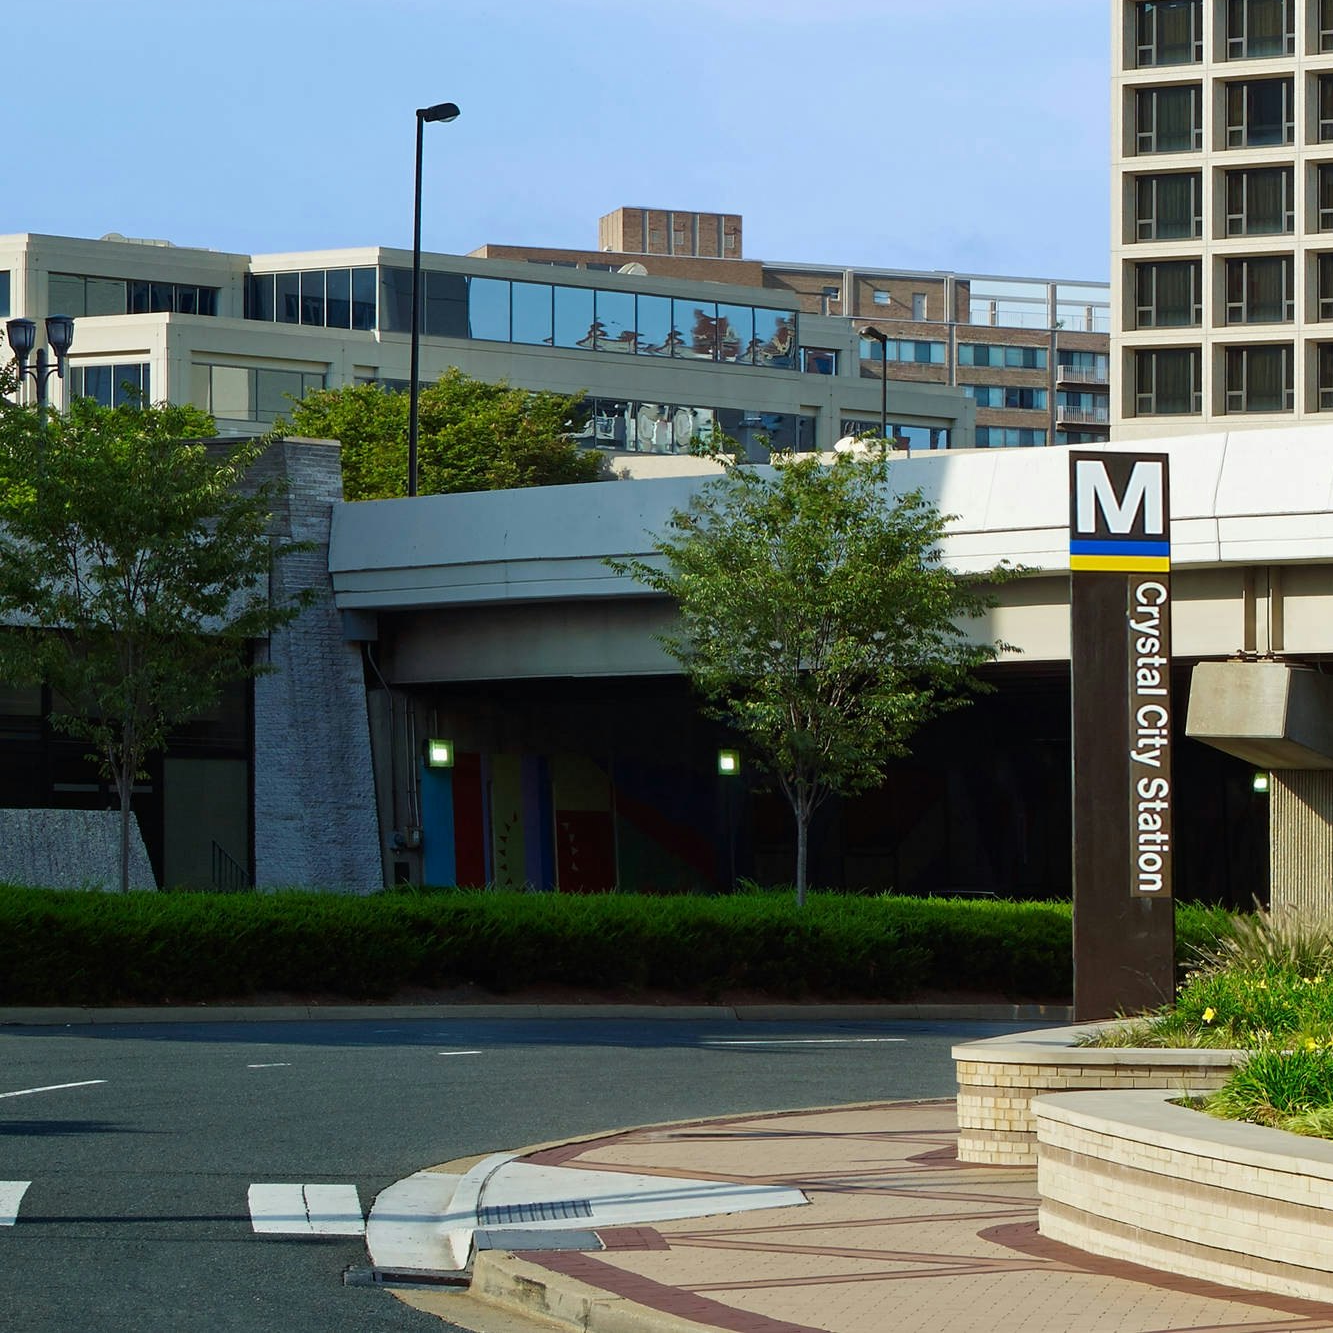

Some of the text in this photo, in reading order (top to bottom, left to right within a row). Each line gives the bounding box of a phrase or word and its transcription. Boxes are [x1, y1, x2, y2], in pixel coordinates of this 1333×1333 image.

[1076, 460, 1164, 535] M
[1130, 581, 1169, 892] Crystal City Station
